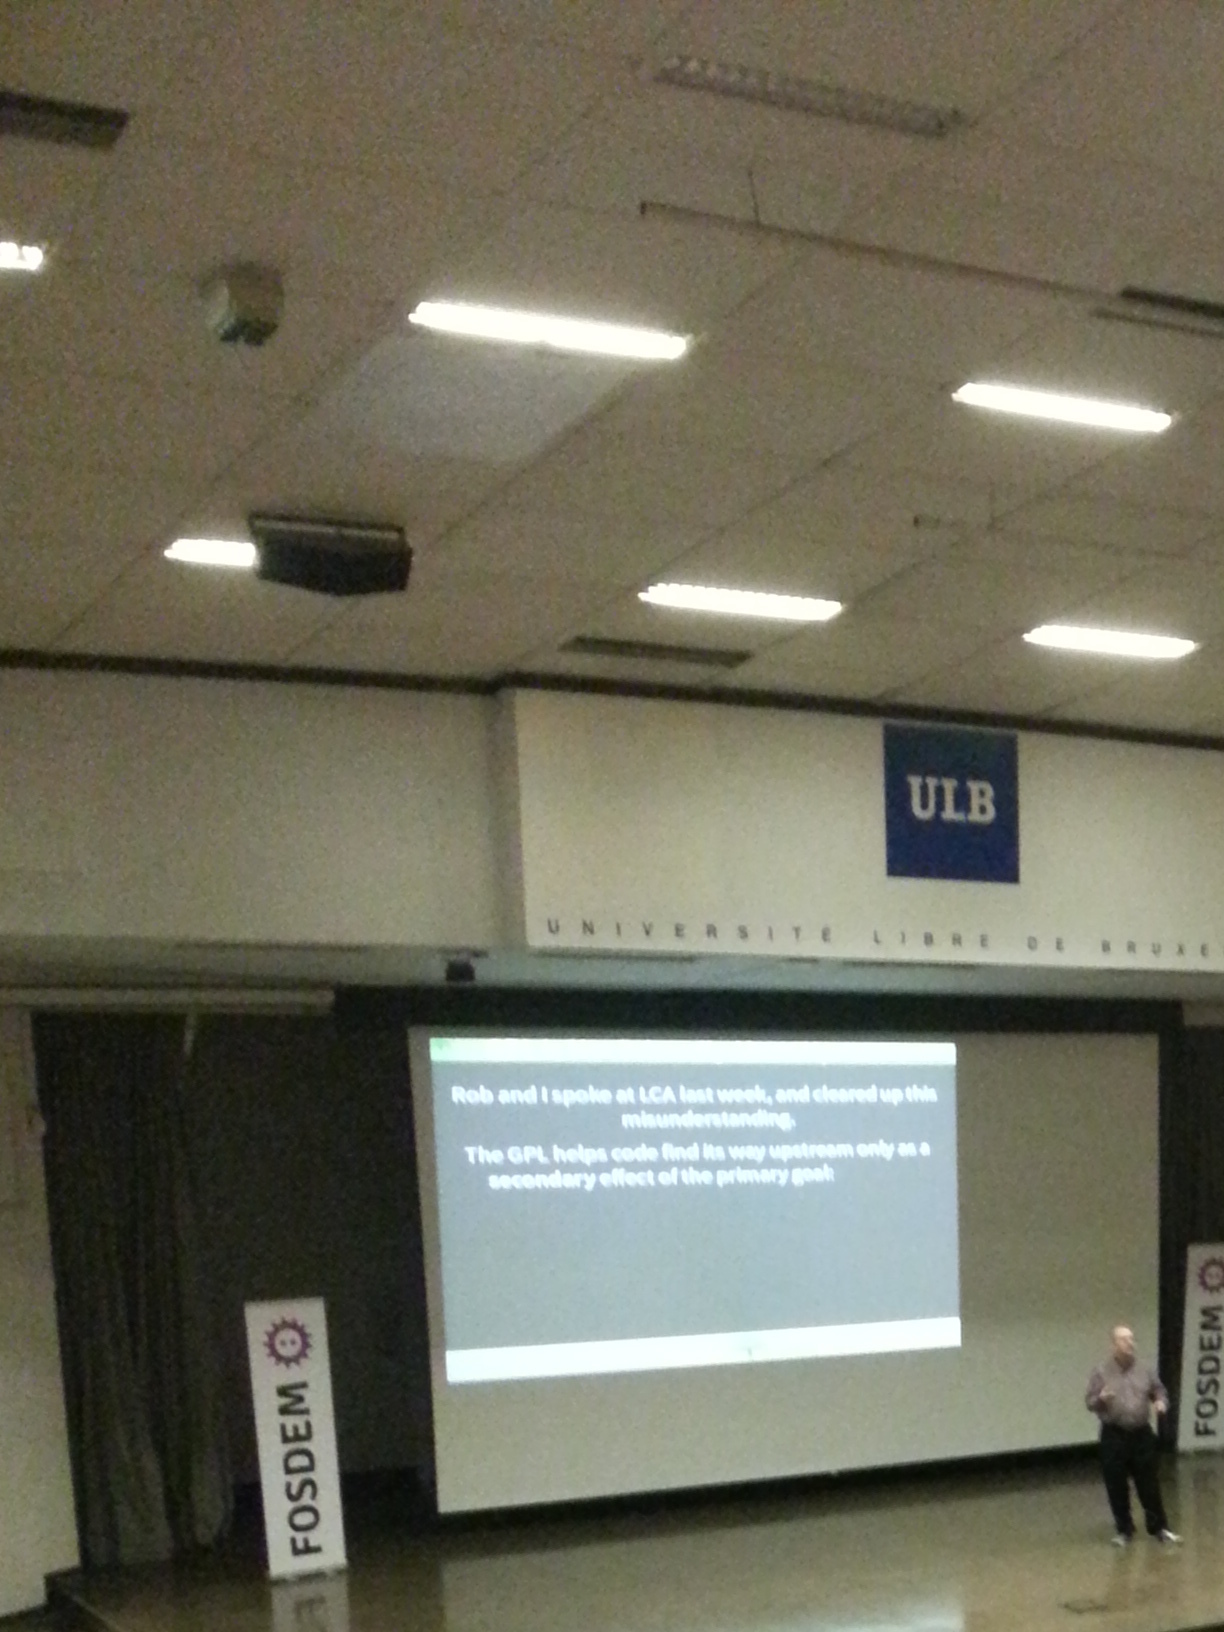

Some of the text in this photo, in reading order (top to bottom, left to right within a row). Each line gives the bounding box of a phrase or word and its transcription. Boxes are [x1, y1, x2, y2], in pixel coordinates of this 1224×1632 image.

[905, 774, 996, 825] ULB
[872, 930, 989, 949] LIBRE
[1027, 935, 1066, 952] DE
[451, 1085, 494, 1104] Rob
[498, 1085, 538, 1104] and
[541, 1086, 548, 1104] I
[551, 1085, 613, 1110] spoke
[616, 1087, 636, 1104] at
[639, 1086, 677, 1104] LCA
[680, 1085, 714, 1104] last
[775, 1084, 810, 1103] and
[812, 1084, 878, 1103] cleared
[880, 1087, 904, 1107] up
[905, 1084, 938, 1103] this
[464, 1139, 932, 1166] The GPL helps code find its way upstream only as a
[488, 1169, 597, 1192] secondary
[599, 1167, 655, 1188] effect
[657, 1167, 679, 1187] of
[681, 1166, 714, 1186] the
[716, 1166, 790, 1189] primary
[1194, 1305, 1224, 1437] FOSDEM
[275, 1380, 323, 1557] FOSDEM
